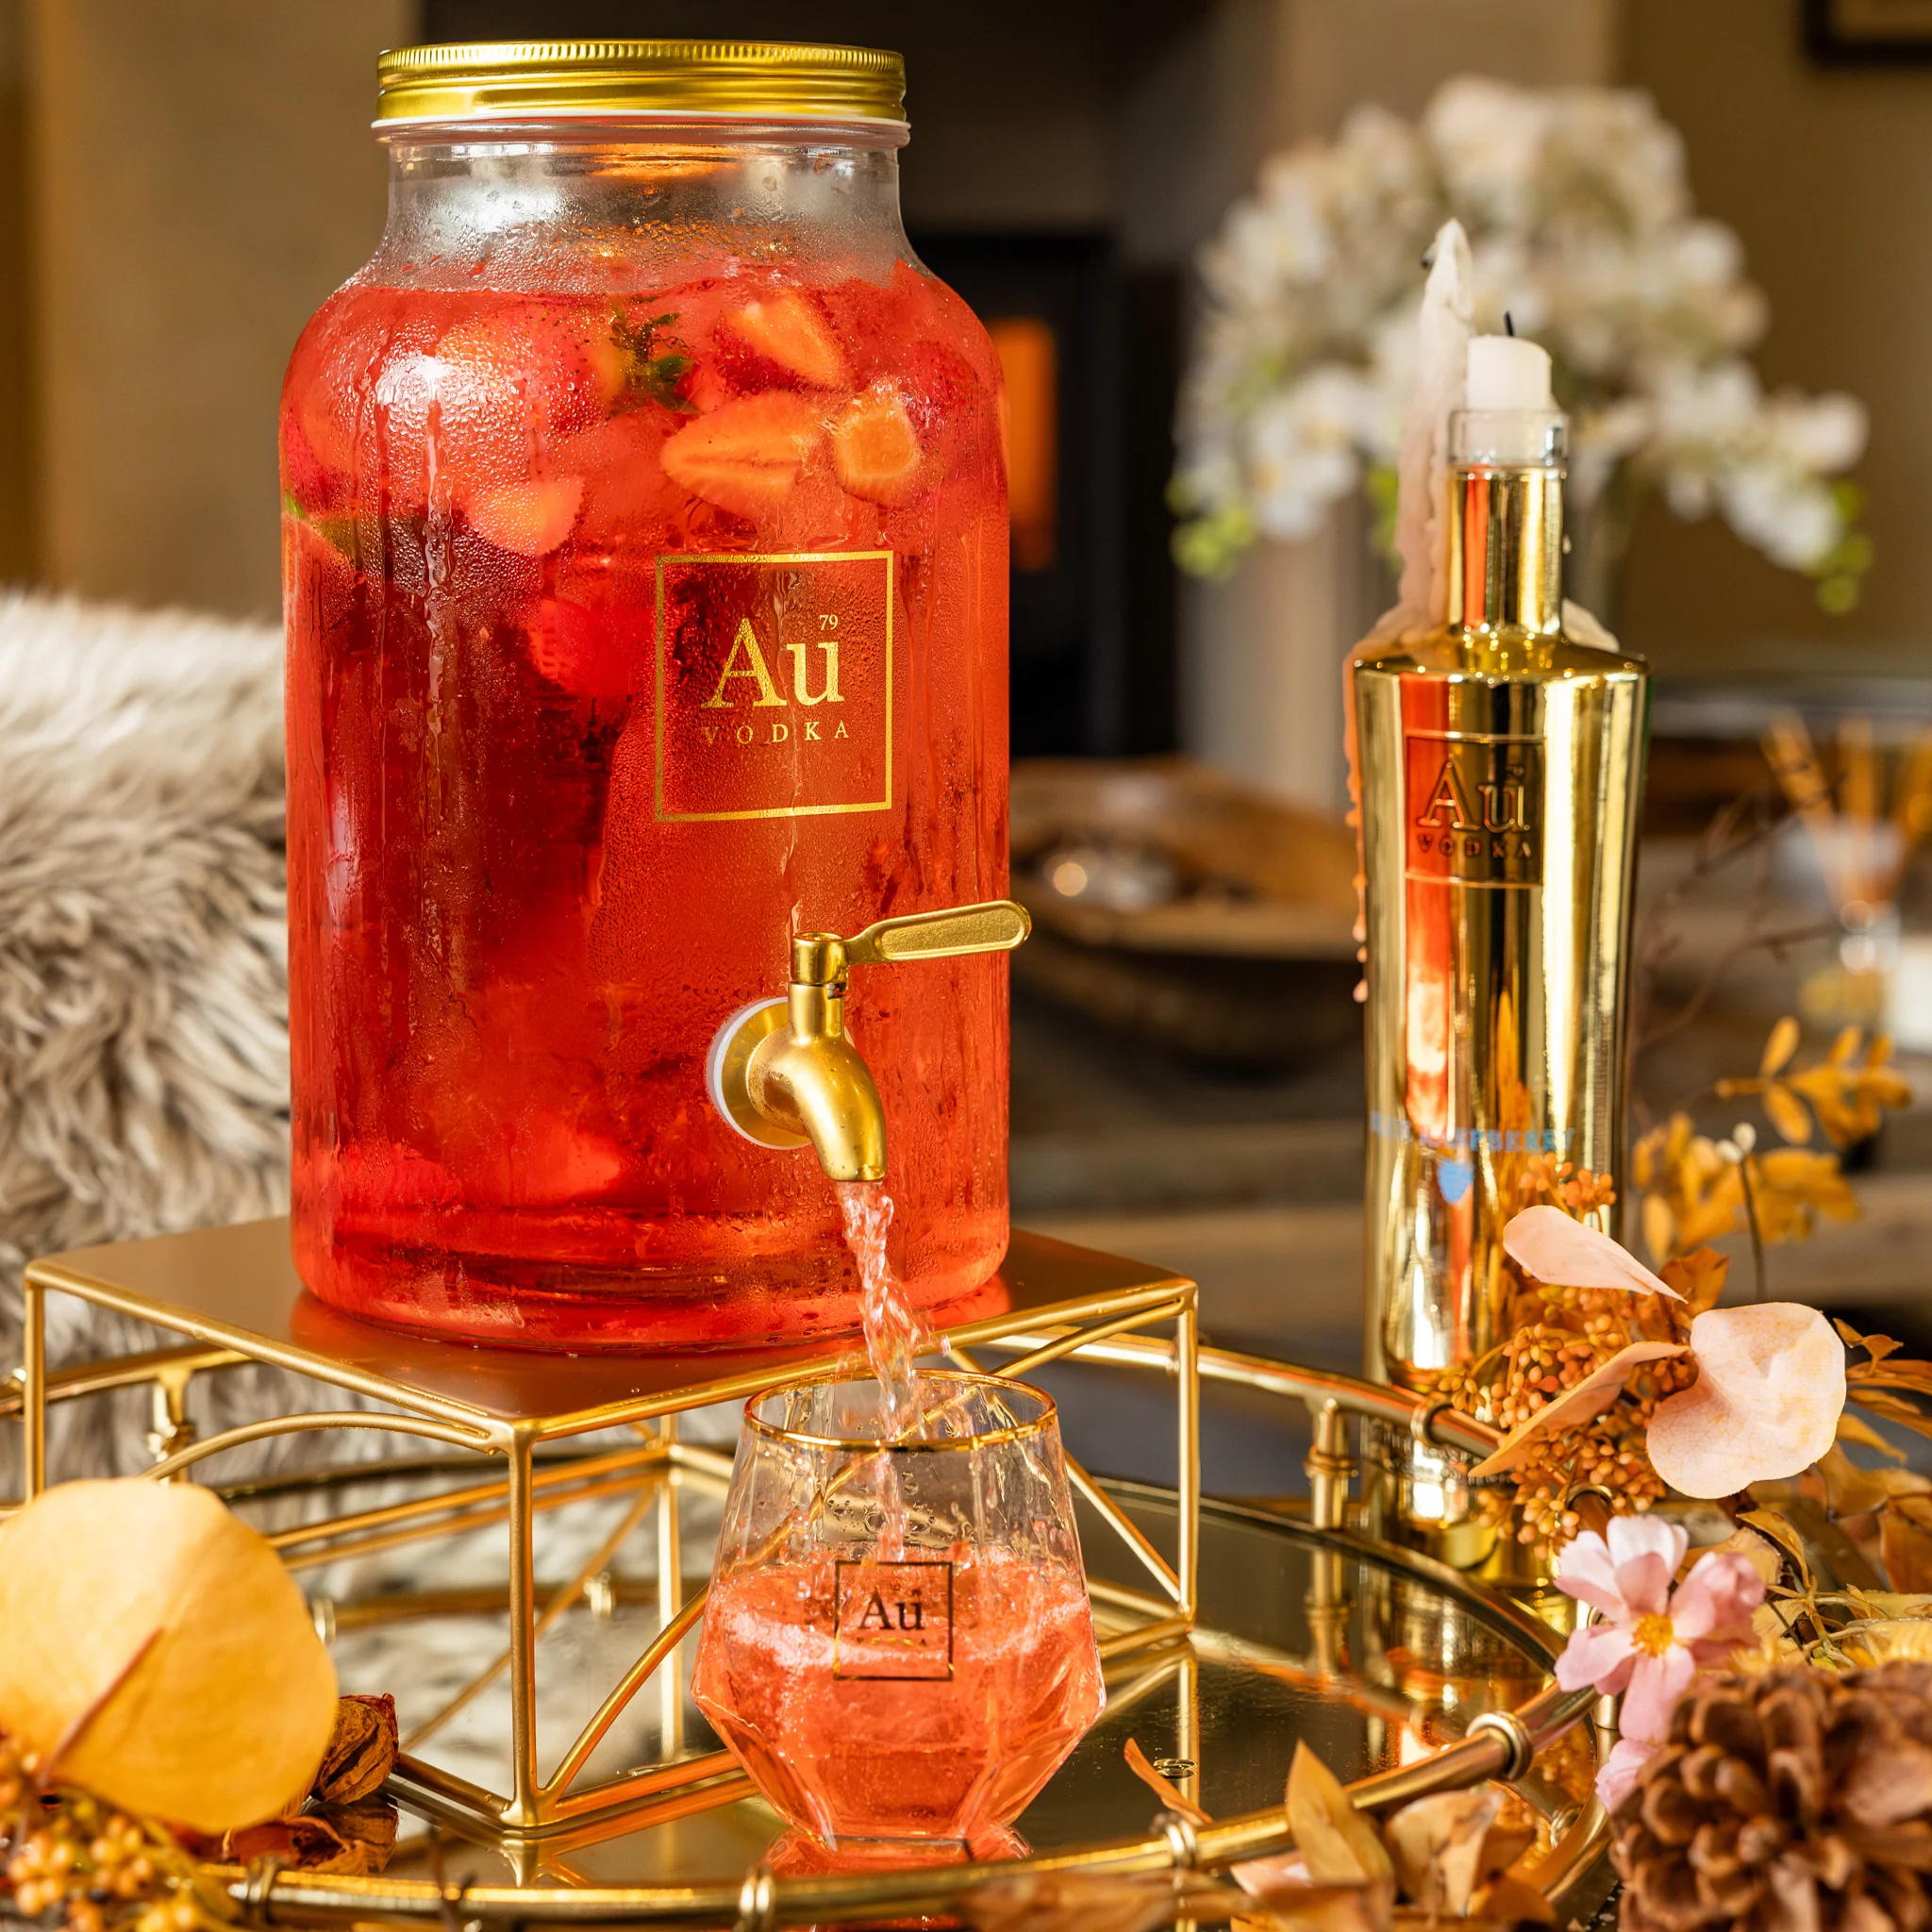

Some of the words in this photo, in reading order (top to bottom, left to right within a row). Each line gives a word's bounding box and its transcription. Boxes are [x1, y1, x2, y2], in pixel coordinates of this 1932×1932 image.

[819, 614, 839, 631] 79
[701, 617, 844, 708] Au
[705, 720, 849, 744] VODKA
[1416, 761, 1530, 833] Au
[1417, 833, 1532, 858] VODKA
[1419, 1126, 1575, 1152] RSPBERRY
[858, 1587, 924, 1630] Au
